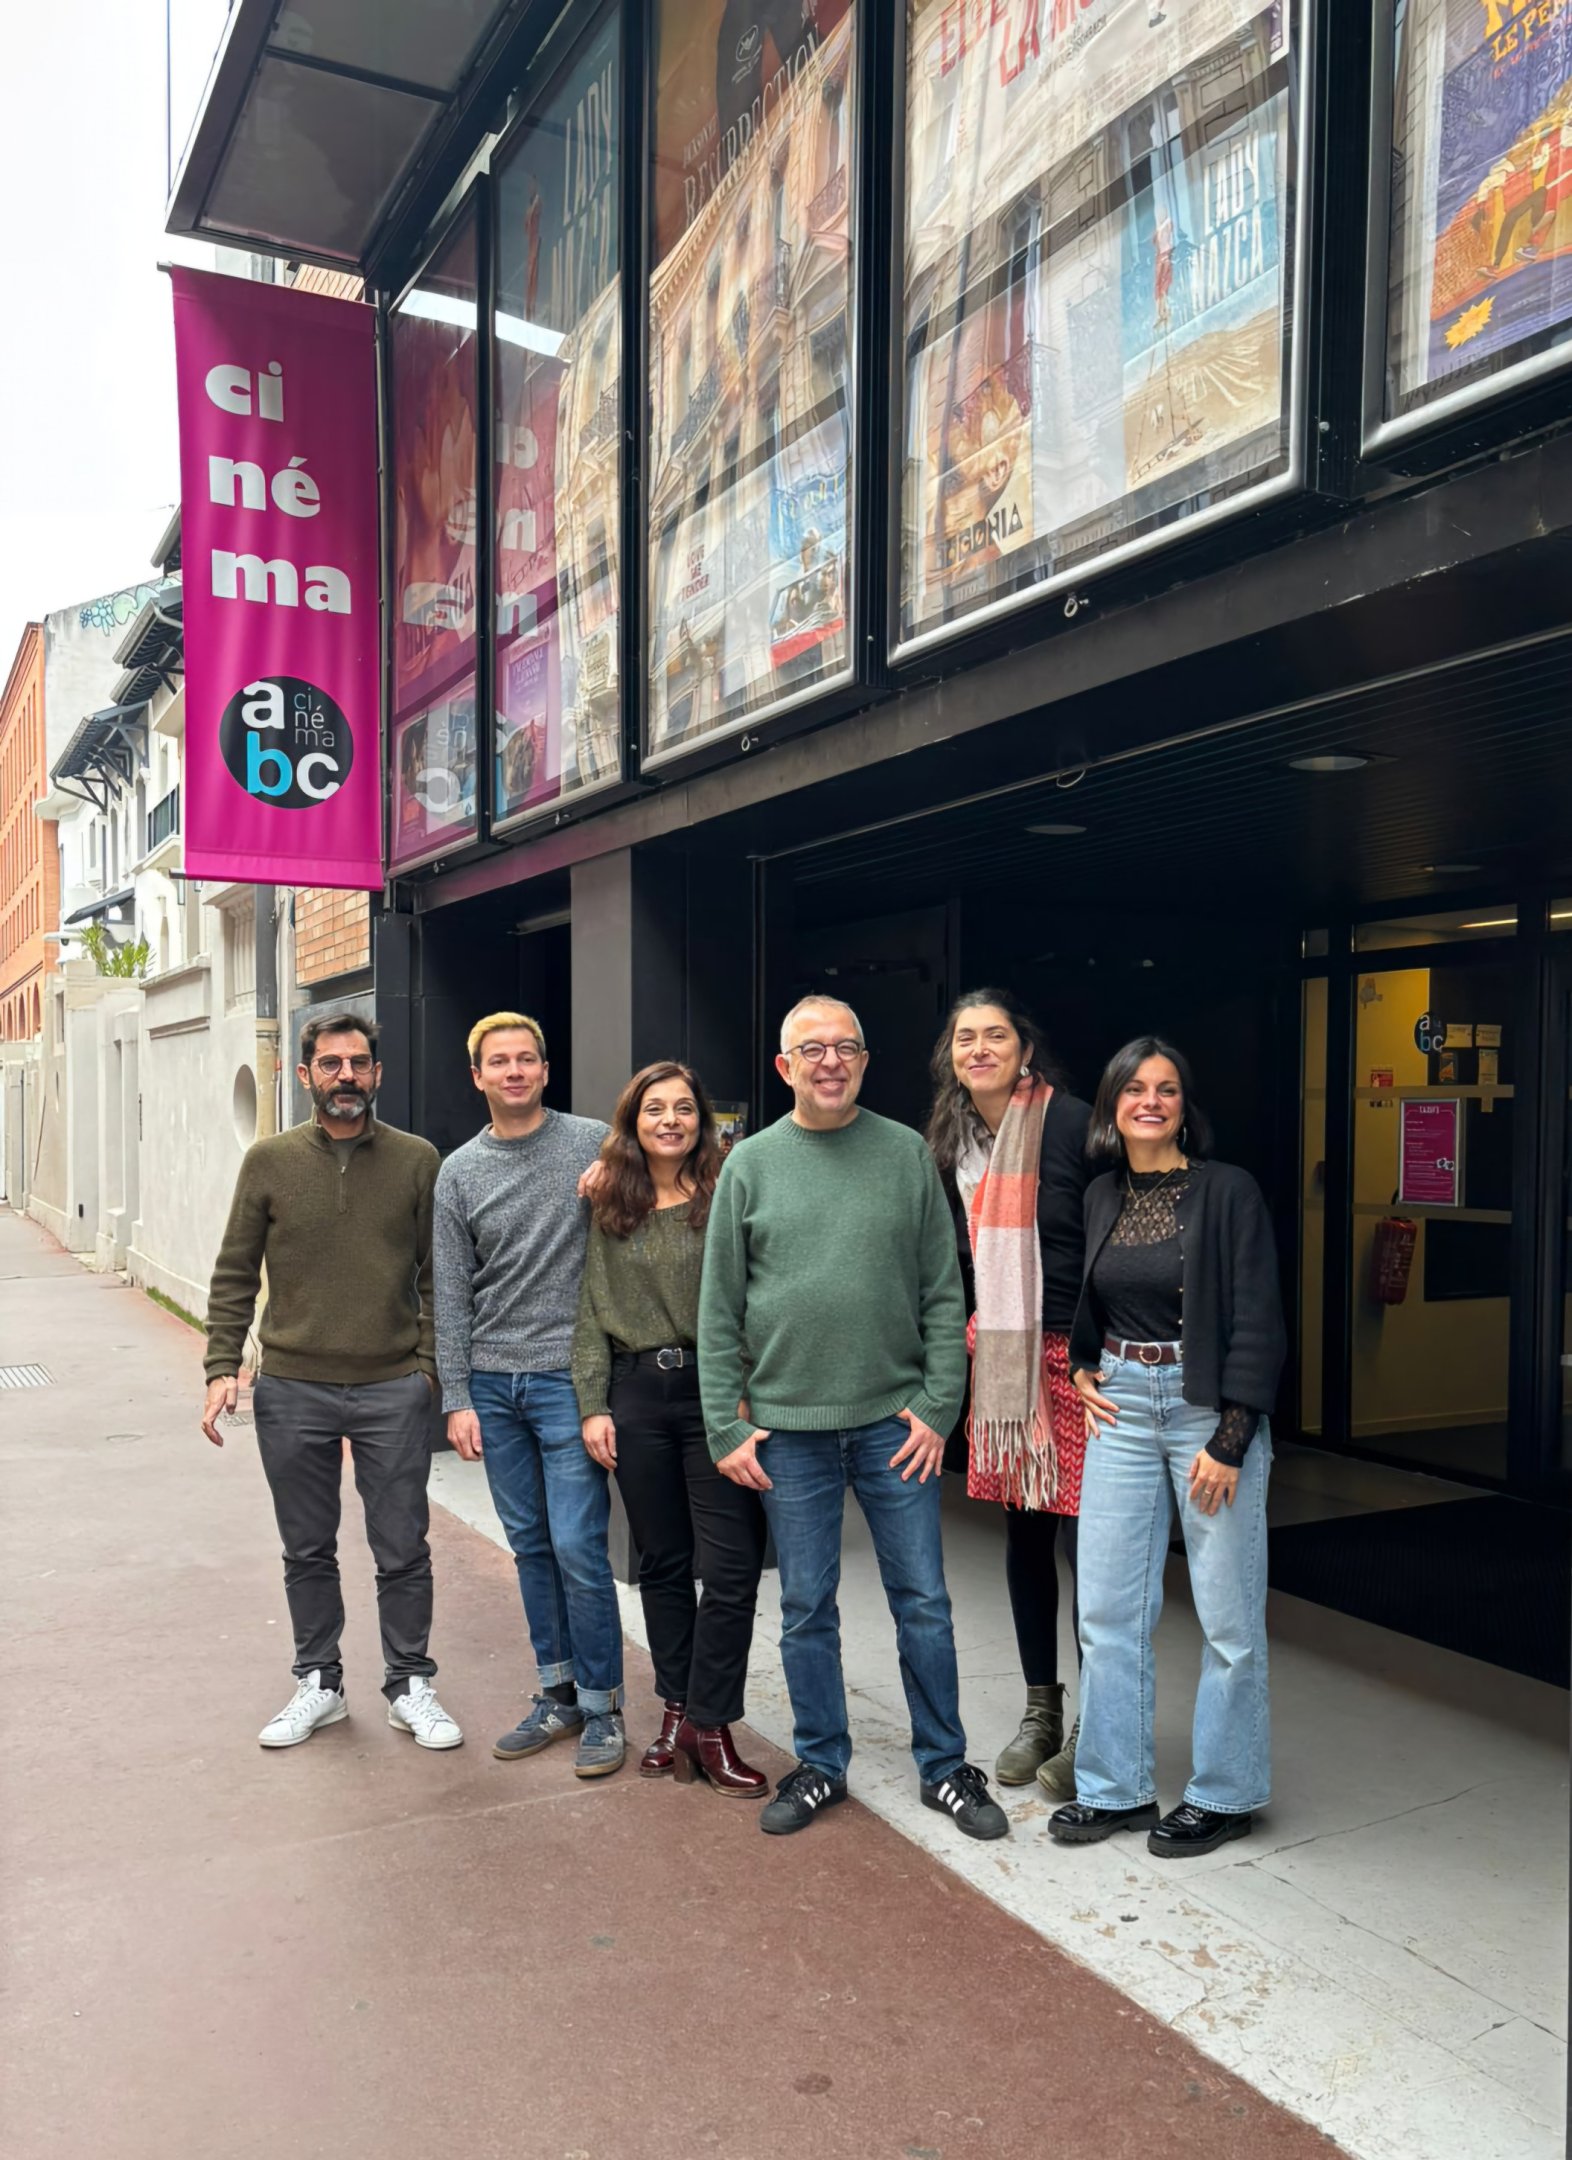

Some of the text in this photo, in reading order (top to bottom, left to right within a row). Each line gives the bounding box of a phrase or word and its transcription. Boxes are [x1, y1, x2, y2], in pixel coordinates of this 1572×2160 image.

[1490, 20, 1519, 62] LE
[563, 60, 612, 227] LADY
[1203, 130, 1260, 237] LADY
[1190, 206, 1264, 318] NAZCA
[204, 361, 285, 423] ci
[208, 456, 321, 518] né
[211, 548, 352, 615] ma
